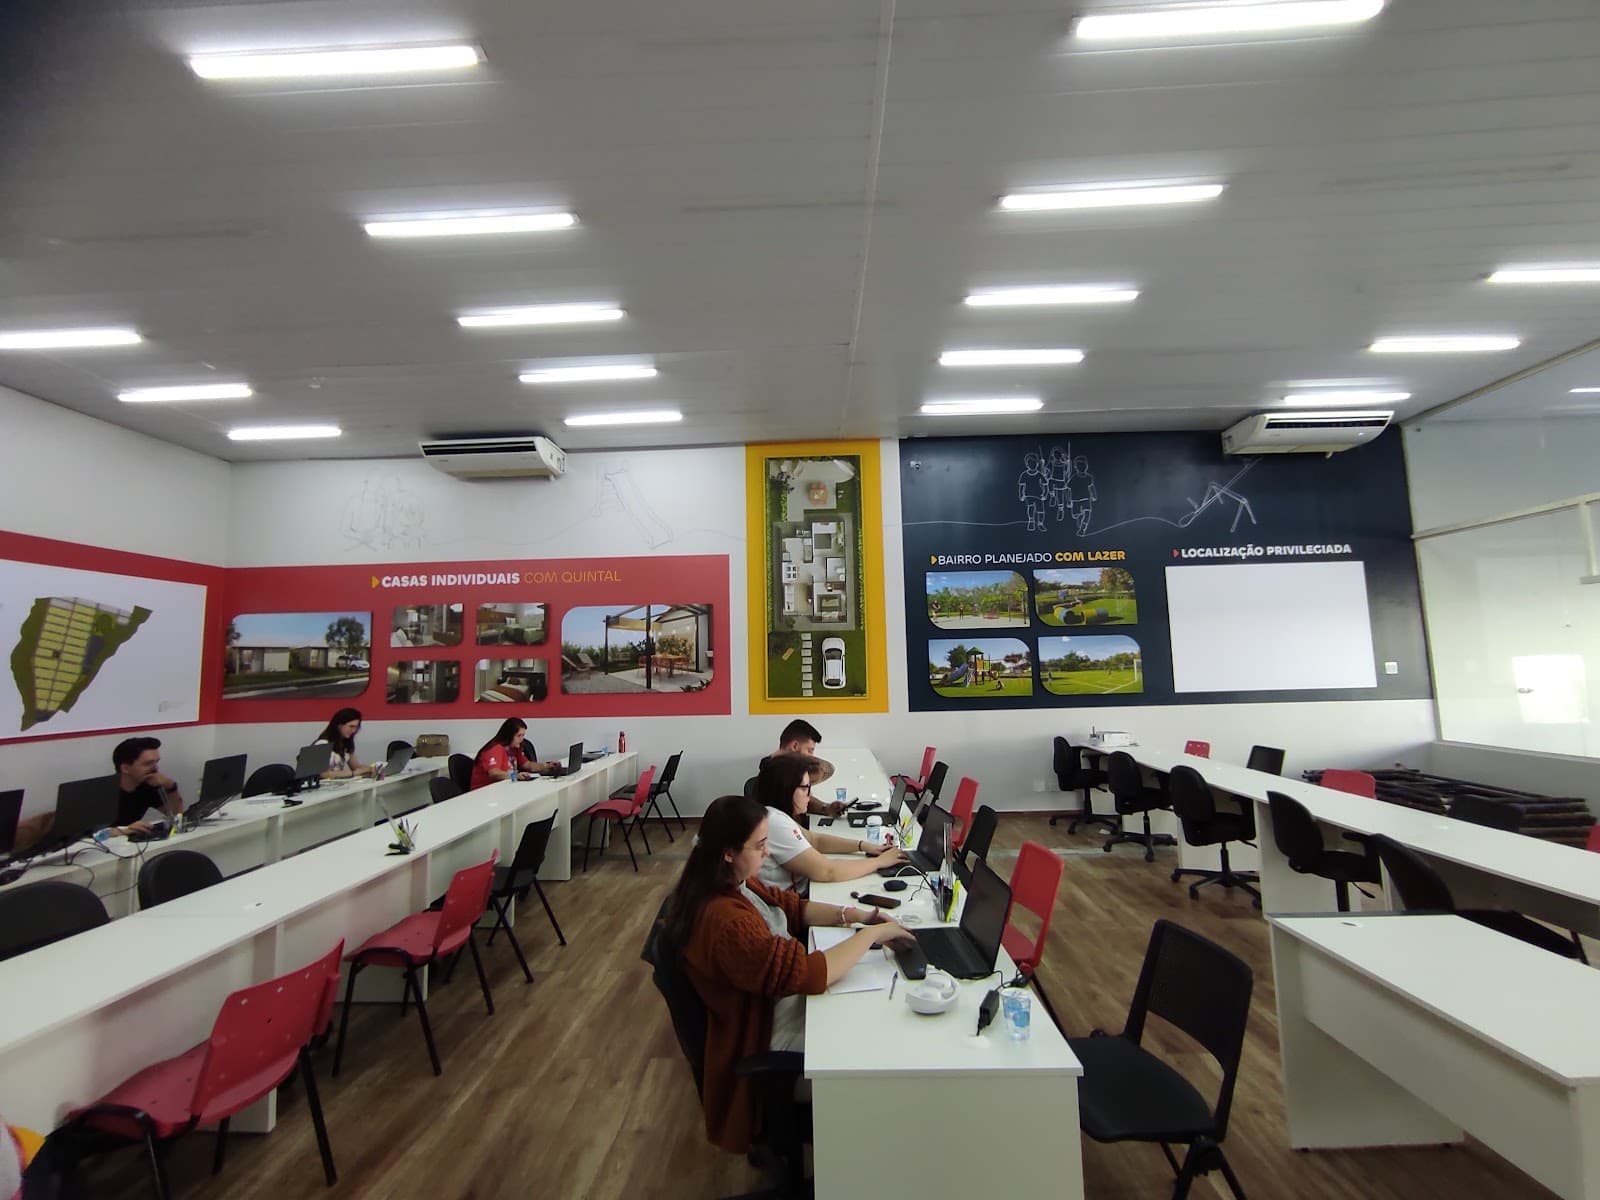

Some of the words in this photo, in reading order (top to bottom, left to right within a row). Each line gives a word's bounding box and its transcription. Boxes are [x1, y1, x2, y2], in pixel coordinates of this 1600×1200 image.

[938, 554, 982, 565] BAIRRO
[984, 552, 1053, 564] PLANEJADO
[1055, 551, 1084, 562] COM
[1087, 550, 1126, 561] LAZER
[1181, 544, 1264, 560] LOCALIZAÇÃO
[1266, 544, 1352, 556] PRIVILEGIADA
[381, 575, 428, 588] CASAS
[431, 572, 520, 587] INDIVIDUAIS
[523, 571, 558, 584] COM
[560, 569, 622, 583] QUINTAL
